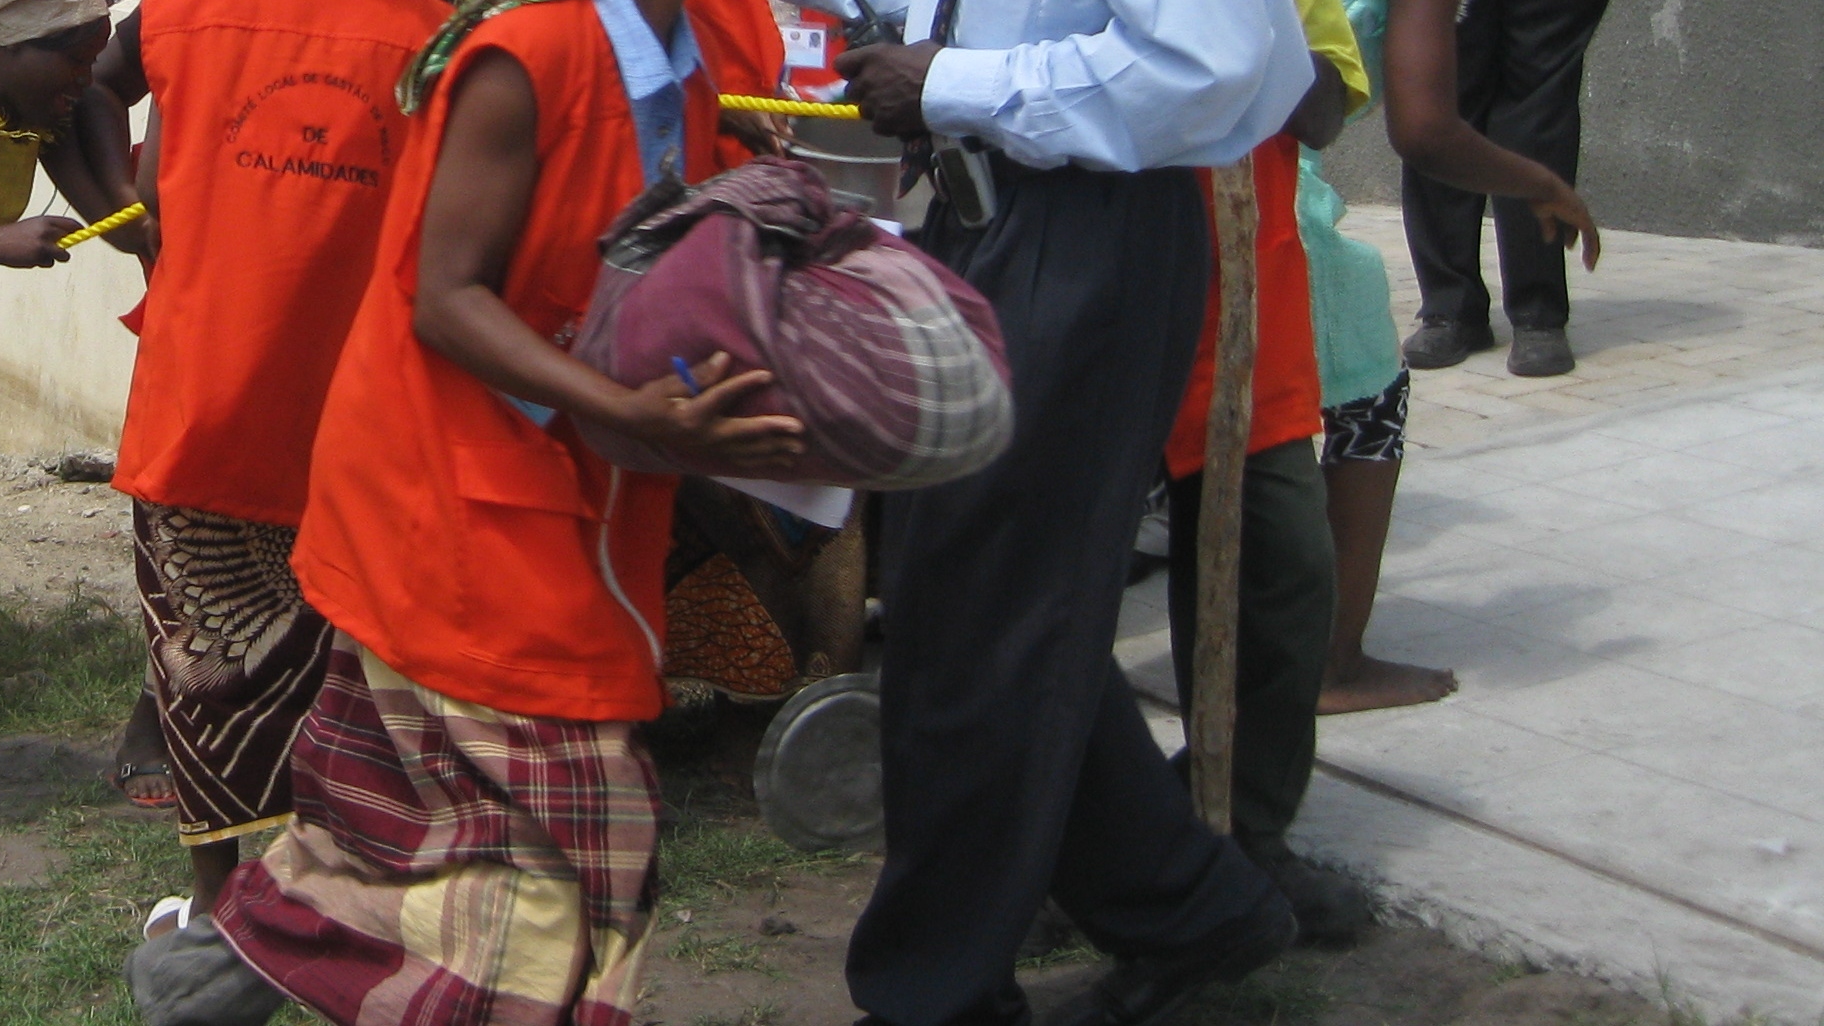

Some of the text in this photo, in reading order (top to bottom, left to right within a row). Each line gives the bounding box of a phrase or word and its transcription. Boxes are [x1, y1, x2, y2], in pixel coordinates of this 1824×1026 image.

[257, 74, 297, 101] LOCAL
[302, 72, 318, 84] DE
[302, 126, 328, 145] DE
[236, 150, 379, 188] CALAMIDADES
